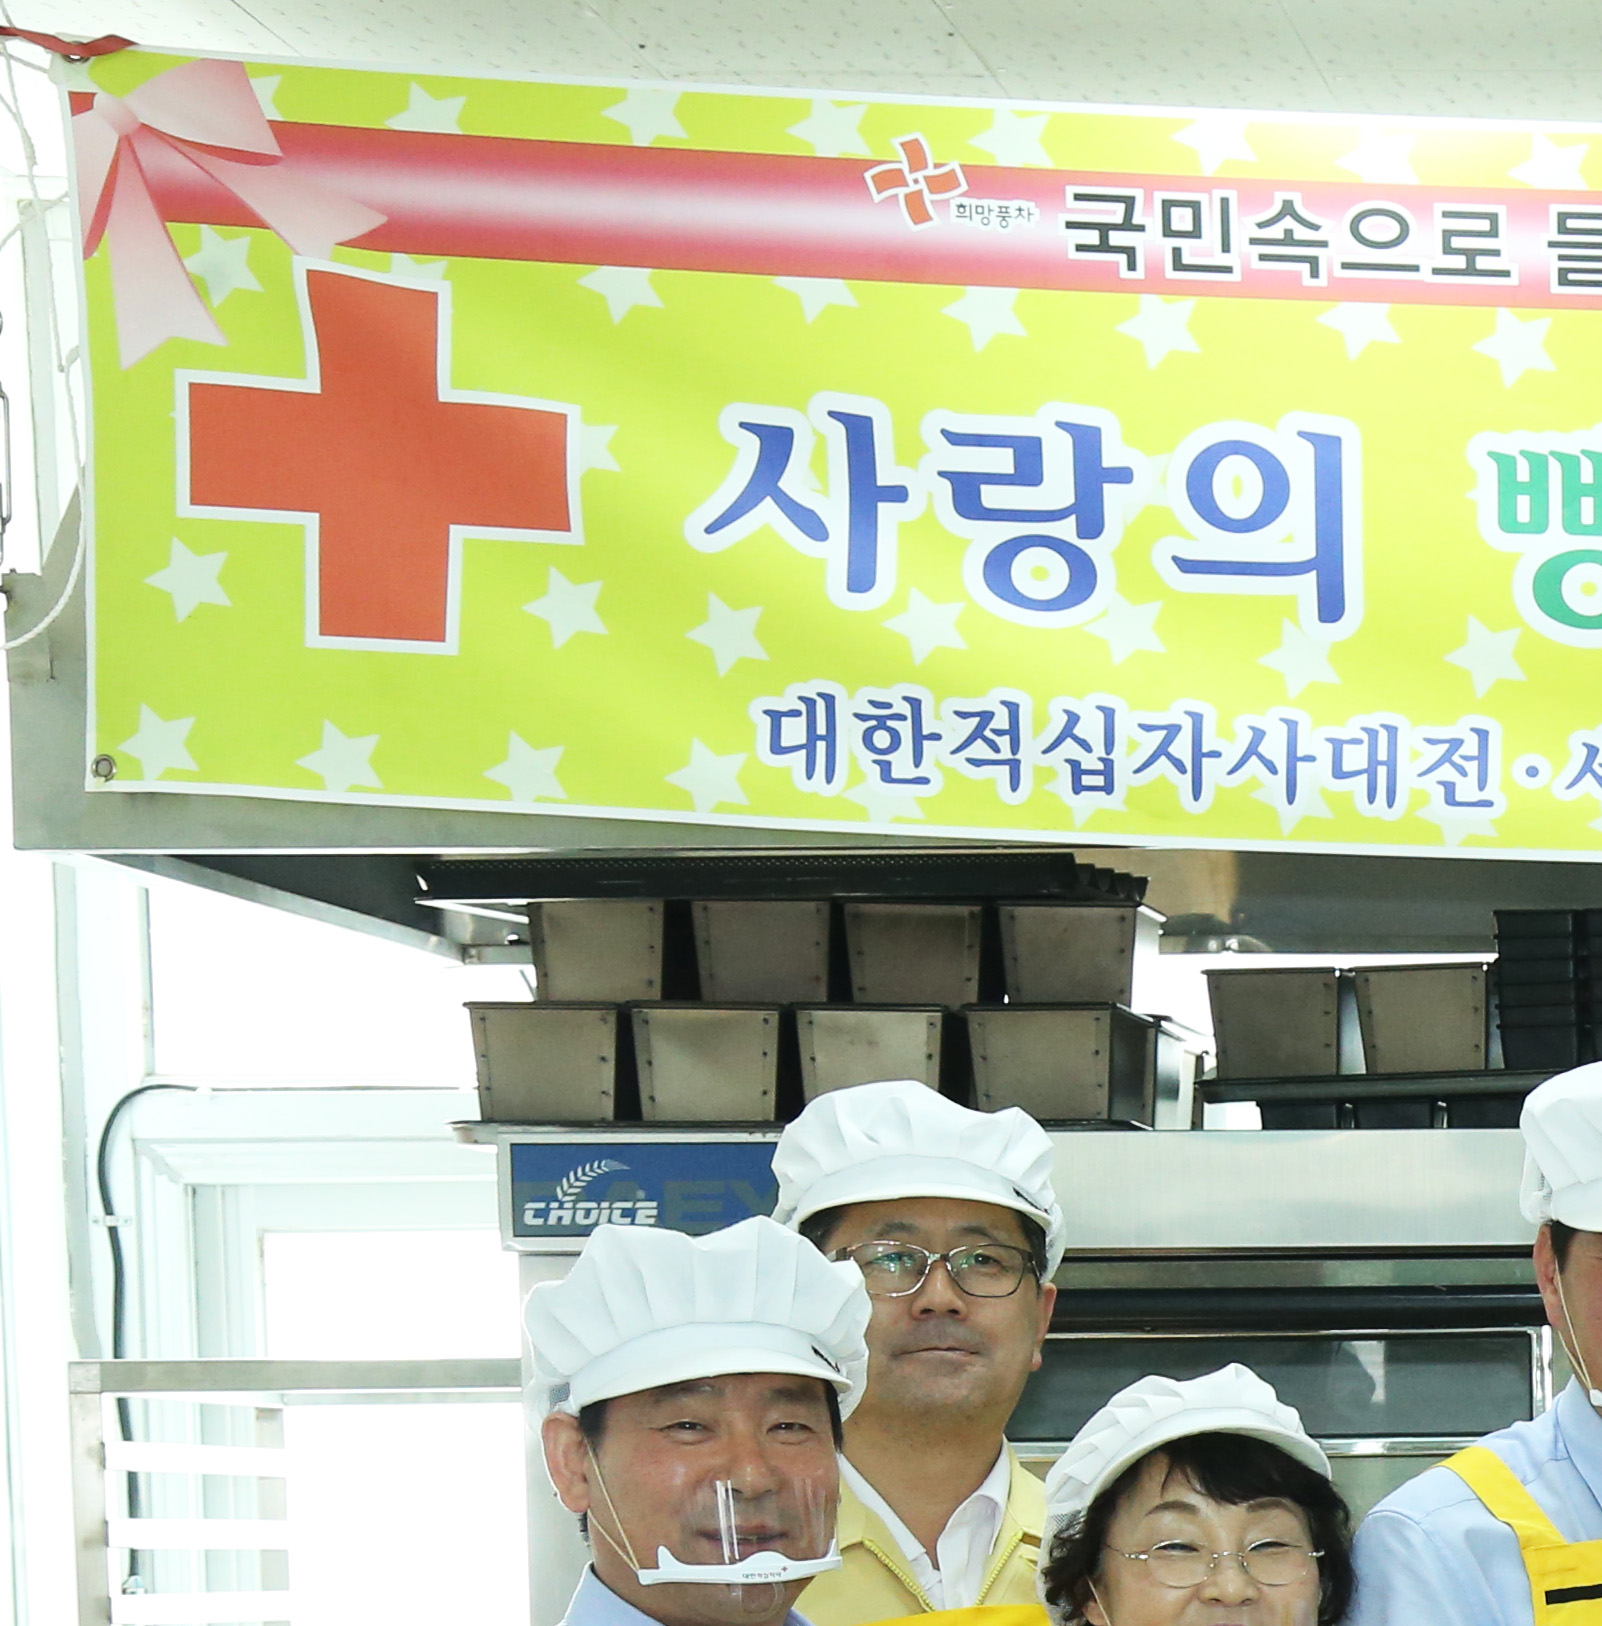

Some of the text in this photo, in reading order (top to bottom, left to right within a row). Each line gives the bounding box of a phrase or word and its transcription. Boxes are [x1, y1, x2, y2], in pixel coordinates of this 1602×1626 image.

[955, 203, 1034, 228] 희망풍차
[1064, 190, 1512, 283] 국민속으로
[704, 409, 1347, 625] 사랑의
[523, 1200, 659, 1226] CHOICE
